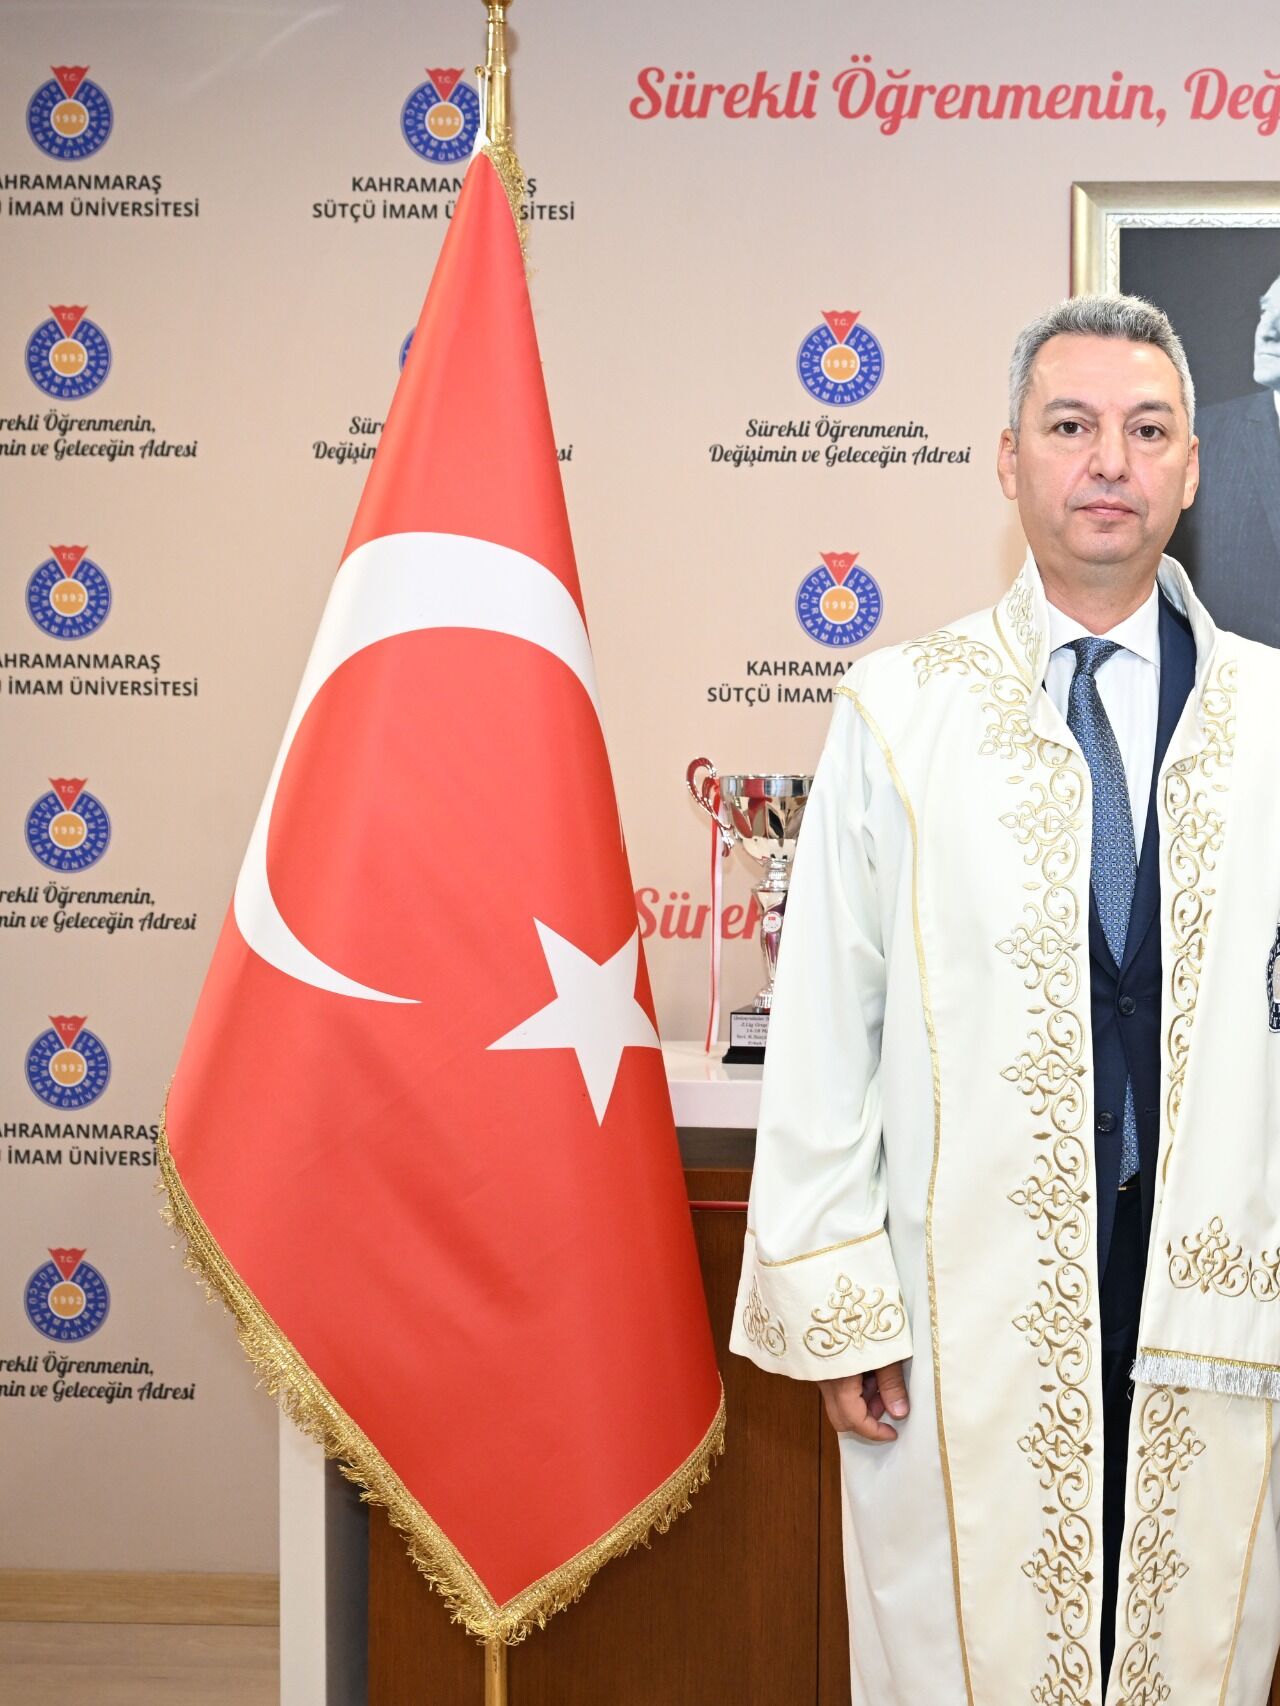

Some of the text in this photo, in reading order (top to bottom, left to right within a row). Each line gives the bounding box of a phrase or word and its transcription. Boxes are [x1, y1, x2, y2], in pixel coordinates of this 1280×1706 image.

[628, 66, 820, 121] Sürekli
[832, 55, 1168, 136] Öğrenmenin,
[56, 115, 85, 124] 1992
[431, 117, 460, 126] 1992
[0, 175, 162, 194] HRAMANMARAŞ
[8, 197, 64, 216] İMAM
[70, 197, 200, 217] ÜNİVERSİTESİ
[312, 199, 376, 223] SÜTÇÜ
[382, 199, 436, 219] İMAM
[55, 354, 84, 363] 1992
[826, 359, 855, 368] 1992
[0, 409, 156, 436] rekli Öğrenmenin,
[745, 416, 929, 443] Sürekli Öğrenmenin,
[30, 444, 49, 457] ve
[53, 438, 135, 462] Geleceğin
[140, 439, 198, 459] Adresi
[313, 441, 376, 464] Değişi
[709, 444, 971, 468] Değişimin ve Geleceğin Adresi
[55, 594, 84, 603] 1992
[825, 601, 854, 610] 1992
[0, 653, 161, 673] HRAMANMARAŞ
[8, 676, 63, 695] İMAM
[70, 676, 199, 697] ÜNİVERSİTESİ
[707, 684, 833, 707] SÜTÇÜ İMAM
[54, 826, 83, 835] 1992
[0, 881, 155, 908] rekli Öğrenmenin,
[30, 916, 49, 928] ve
[53, 910, 134, 935] Geleceğin
[138, 912, 197, 931] Adresi
[635, 887, 761, 939] Sürek
[54, 1064, 83, 1073] 1992
[0, 1123, 158, 1144] HRAMANMARAŞ
[8, 1145, 158, 1166] İMAM ÜNİVERSİ
[53, 1296, 82, 1305] 1992
[0, 1350, 154, 1378] rekli Öğrenmenin,
[30, 1385, 48, 1397] ve
[52, 1379, 133, 1404] Geleceğin
[137, 1381, 196, 1401] Adresi
